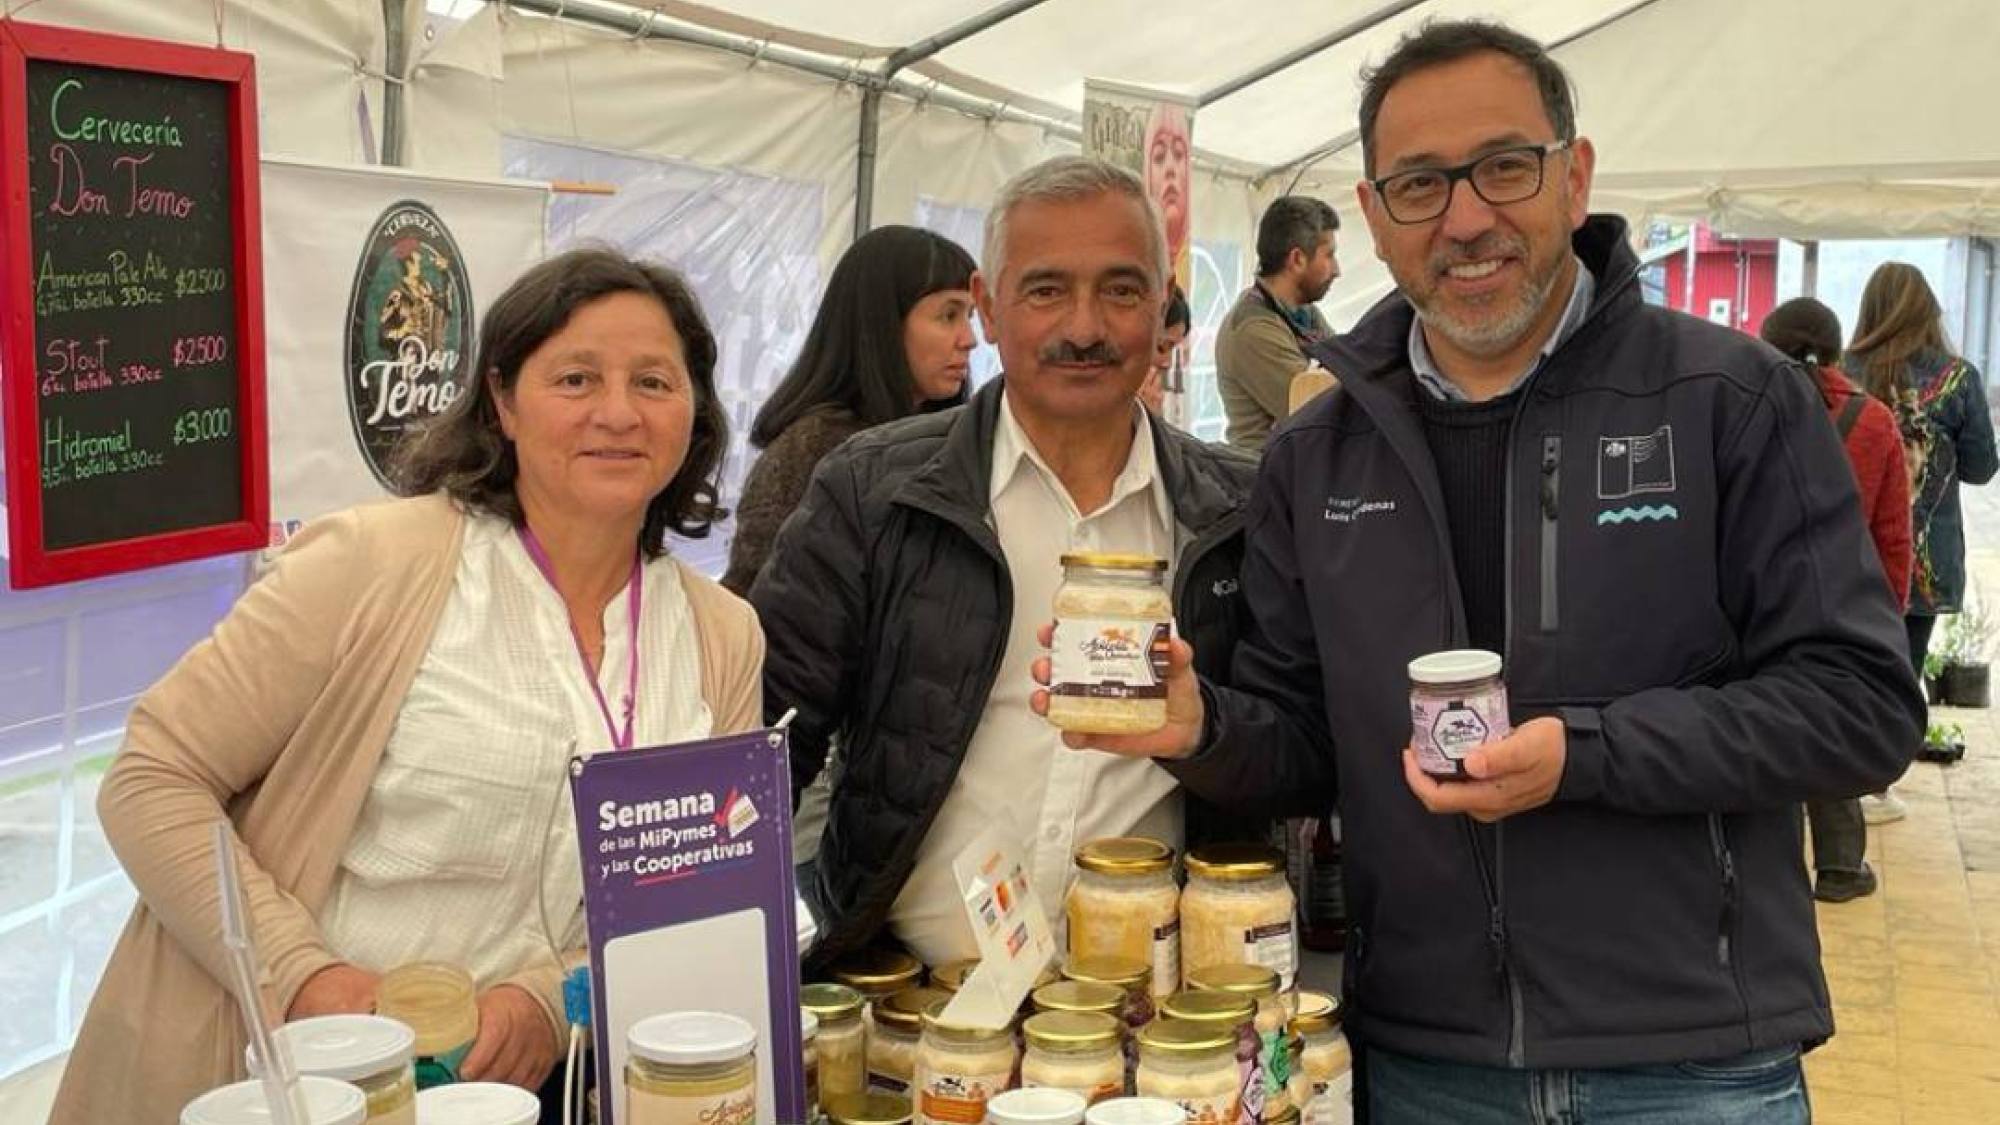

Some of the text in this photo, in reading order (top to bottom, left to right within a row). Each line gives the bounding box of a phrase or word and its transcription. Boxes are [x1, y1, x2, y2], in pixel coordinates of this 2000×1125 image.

[51, 79, 182, 147] Cervecería
[50, 143, 195, 218] Don Temo
[36, 249, 226, 298] American Pale Ale $2500
[46, 334, 227, 375] Stout $2500
[397, 335, 459, 378] Don
[360, 360, 466, 425] Temo
[44, 407, 233, 470] Hidromiel $3000
[600, 792, 716, 831] Semana
[600, 822, 717, 853] de las MiPymes
[601, 839, 754, 879] y las Cooperativas
